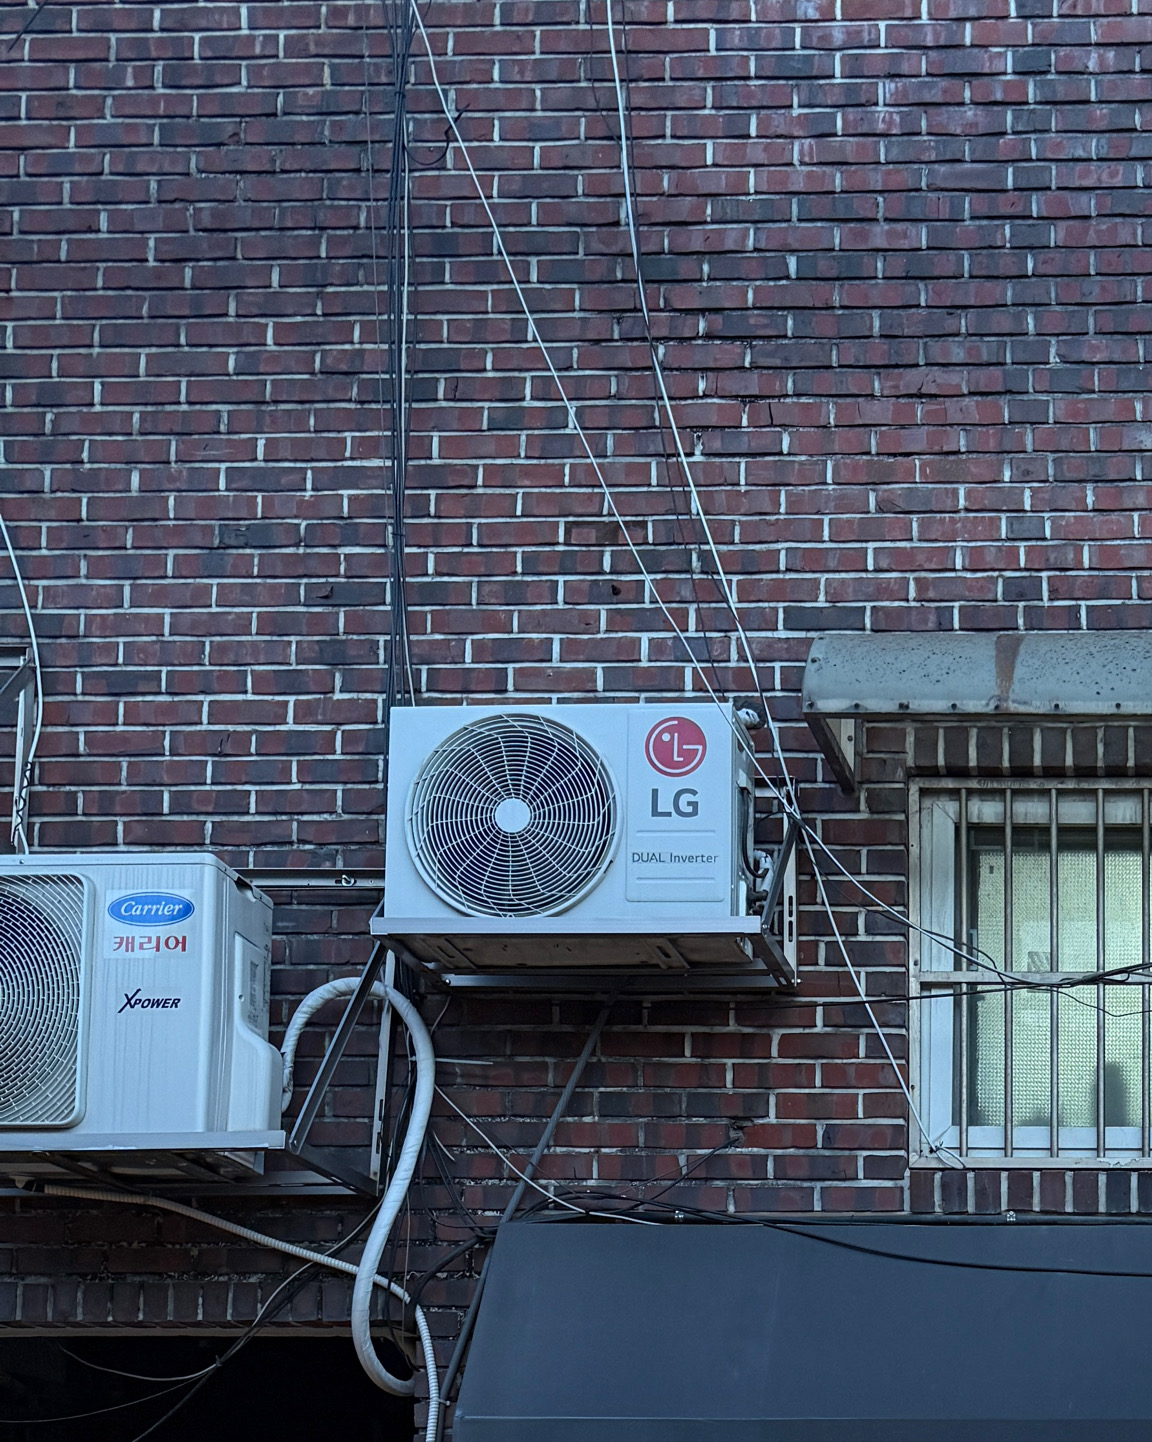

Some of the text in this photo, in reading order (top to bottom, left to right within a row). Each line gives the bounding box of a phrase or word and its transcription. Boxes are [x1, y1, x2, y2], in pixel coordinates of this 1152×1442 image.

[651, 788, 699, 818] LG
[632, 852, 719, 863] DUAL Inverter
[120, 901, 183, 917] Carrier
[113, 935, 188, 953] 캐리어
[117, 988, 182, 1013] XPOWER
